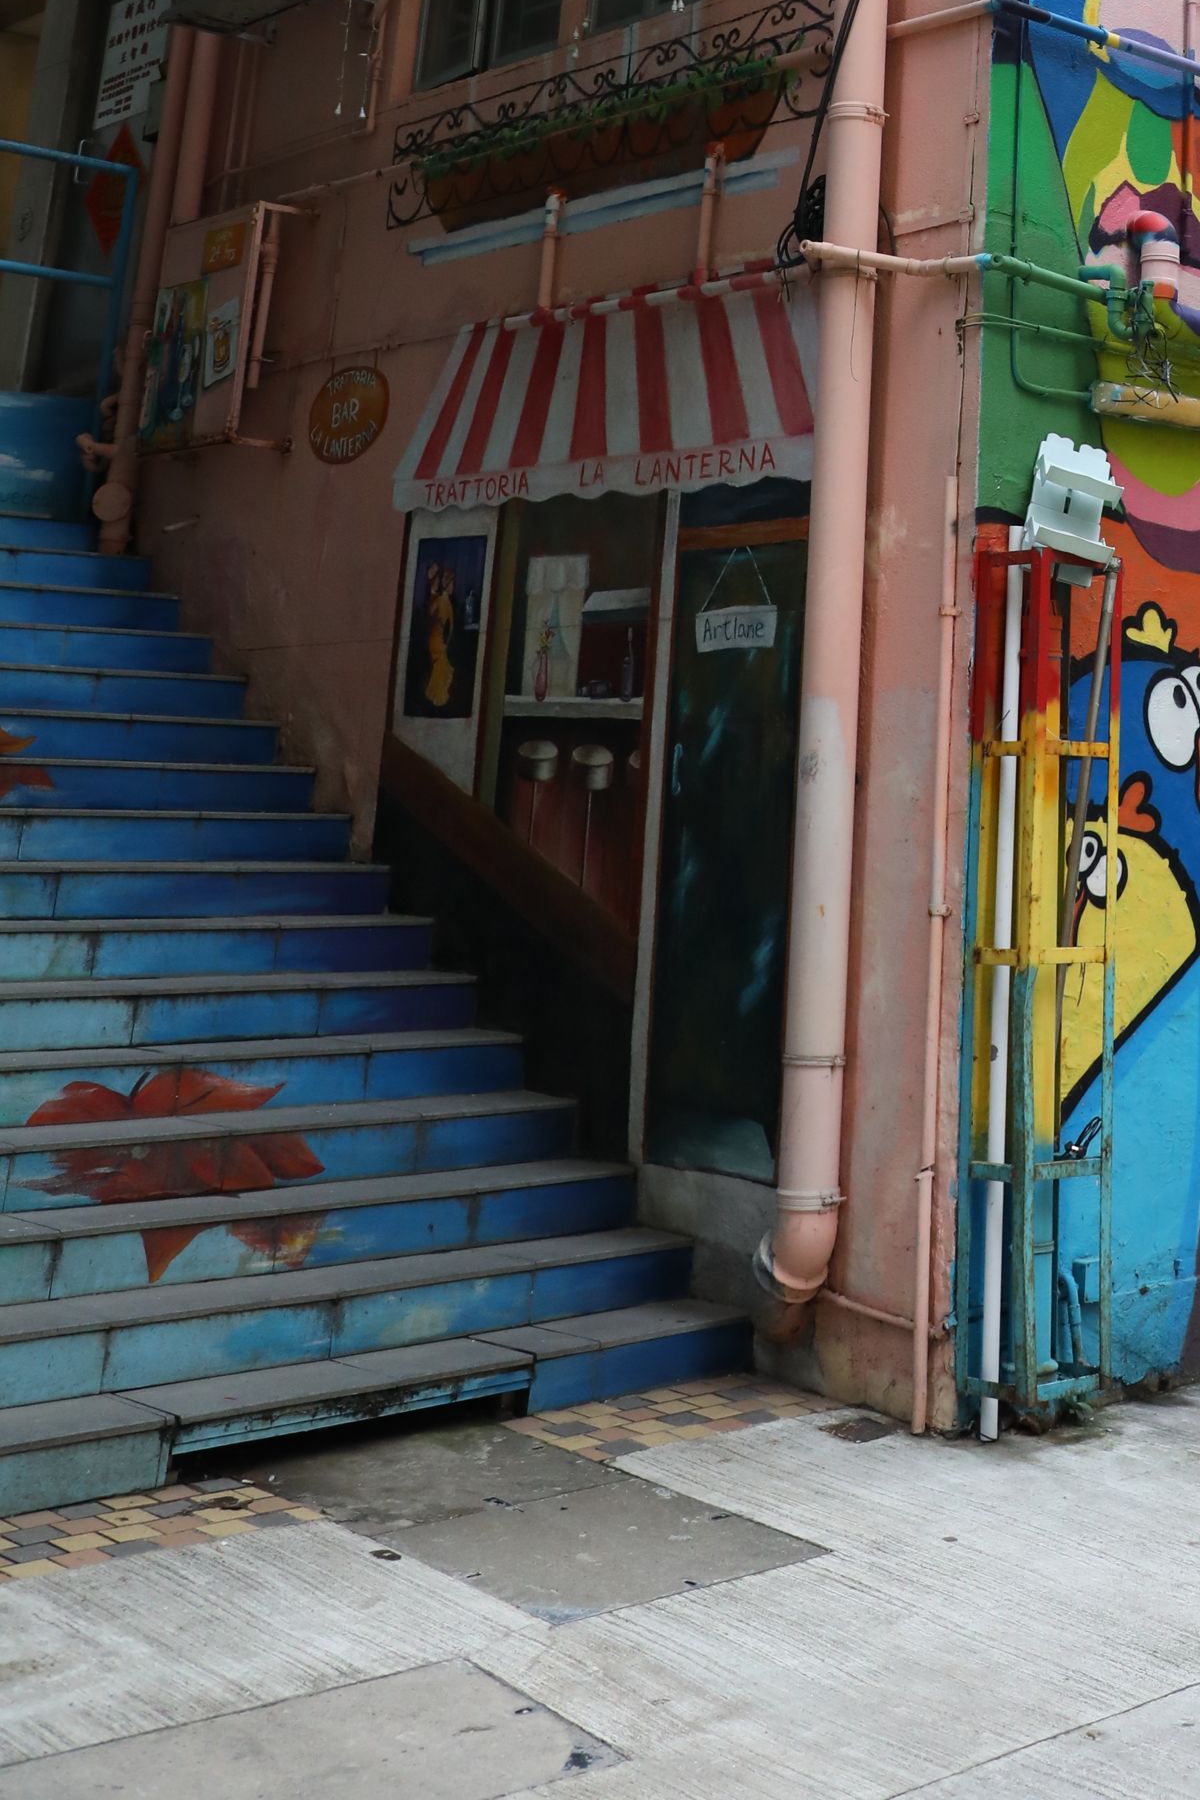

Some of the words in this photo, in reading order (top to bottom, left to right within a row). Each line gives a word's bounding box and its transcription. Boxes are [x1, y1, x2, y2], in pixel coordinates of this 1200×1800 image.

[331, 398, 360, 428] BAR
[425, 471, 529, 506] TRATTORIA
[579, 462, 605, 488] LA
[634, 442, 776, 486] LANTERNA
[702, 615, 765, 643] Artlane
